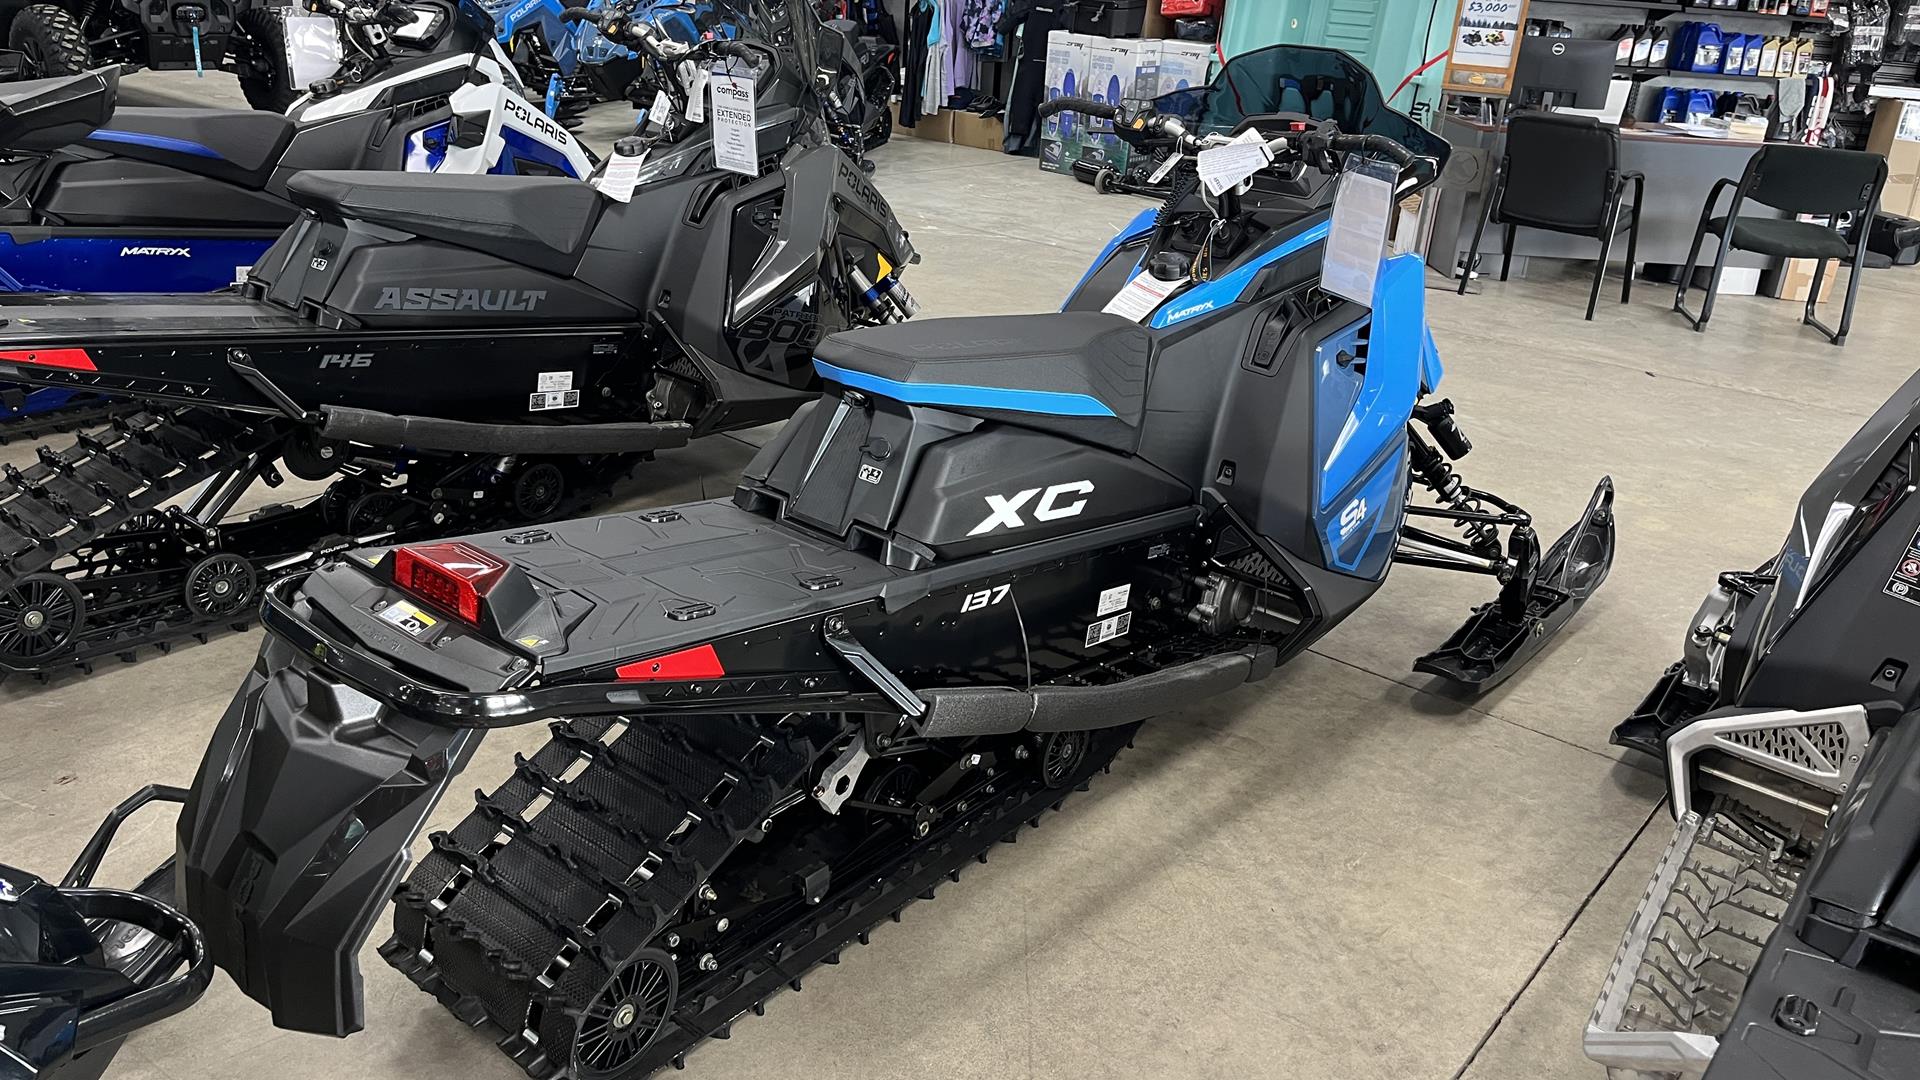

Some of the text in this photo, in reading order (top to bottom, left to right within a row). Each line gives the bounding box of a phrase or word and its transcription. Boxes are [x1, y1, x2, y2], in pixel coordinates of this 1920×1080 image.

[1468, 1, 1508, 13] $3,000
[716, 86, 749, 99] compass
[503, 98, 567, 145] POLARIS
[717, 108, 752, 122] EXTENDED
[717, 117, 752, 127] PROTECTION
[838, 162, 887, 218] POLARIS
[120, 247, 191, 258] MATRYX
[374, 287, 547, 311] ASSAULT
[1166, 300, 1214, 324] MATRYX
[319, 353, 374, 369] 146
[966, 479, 1095, 537] XC
[1340, 496, 1367, 536] S4
[960, 583, 1011, 613] 137
